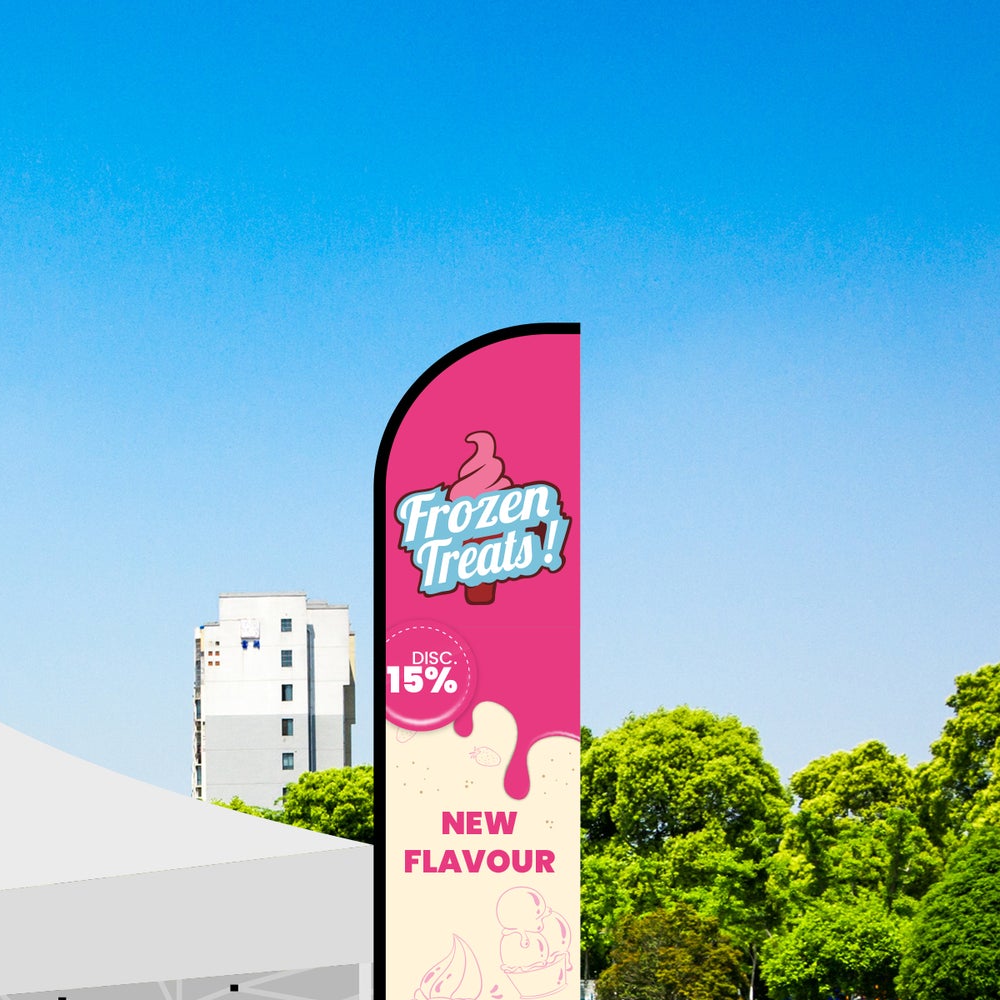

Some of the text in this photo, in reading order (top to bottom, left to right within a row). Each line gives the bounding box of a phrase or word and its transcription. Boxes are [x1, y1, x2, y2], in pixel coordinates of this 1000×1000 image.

[400, 487, 549, 542] Frozen
[416, 519, 558, 587] Treats!
[412, 651, 457, 665] DISC.
[386, 665, 457, 693] 15%
[442, 811, 517, 834] NEW
[404, 849, 555, 873] FLAVOUR
